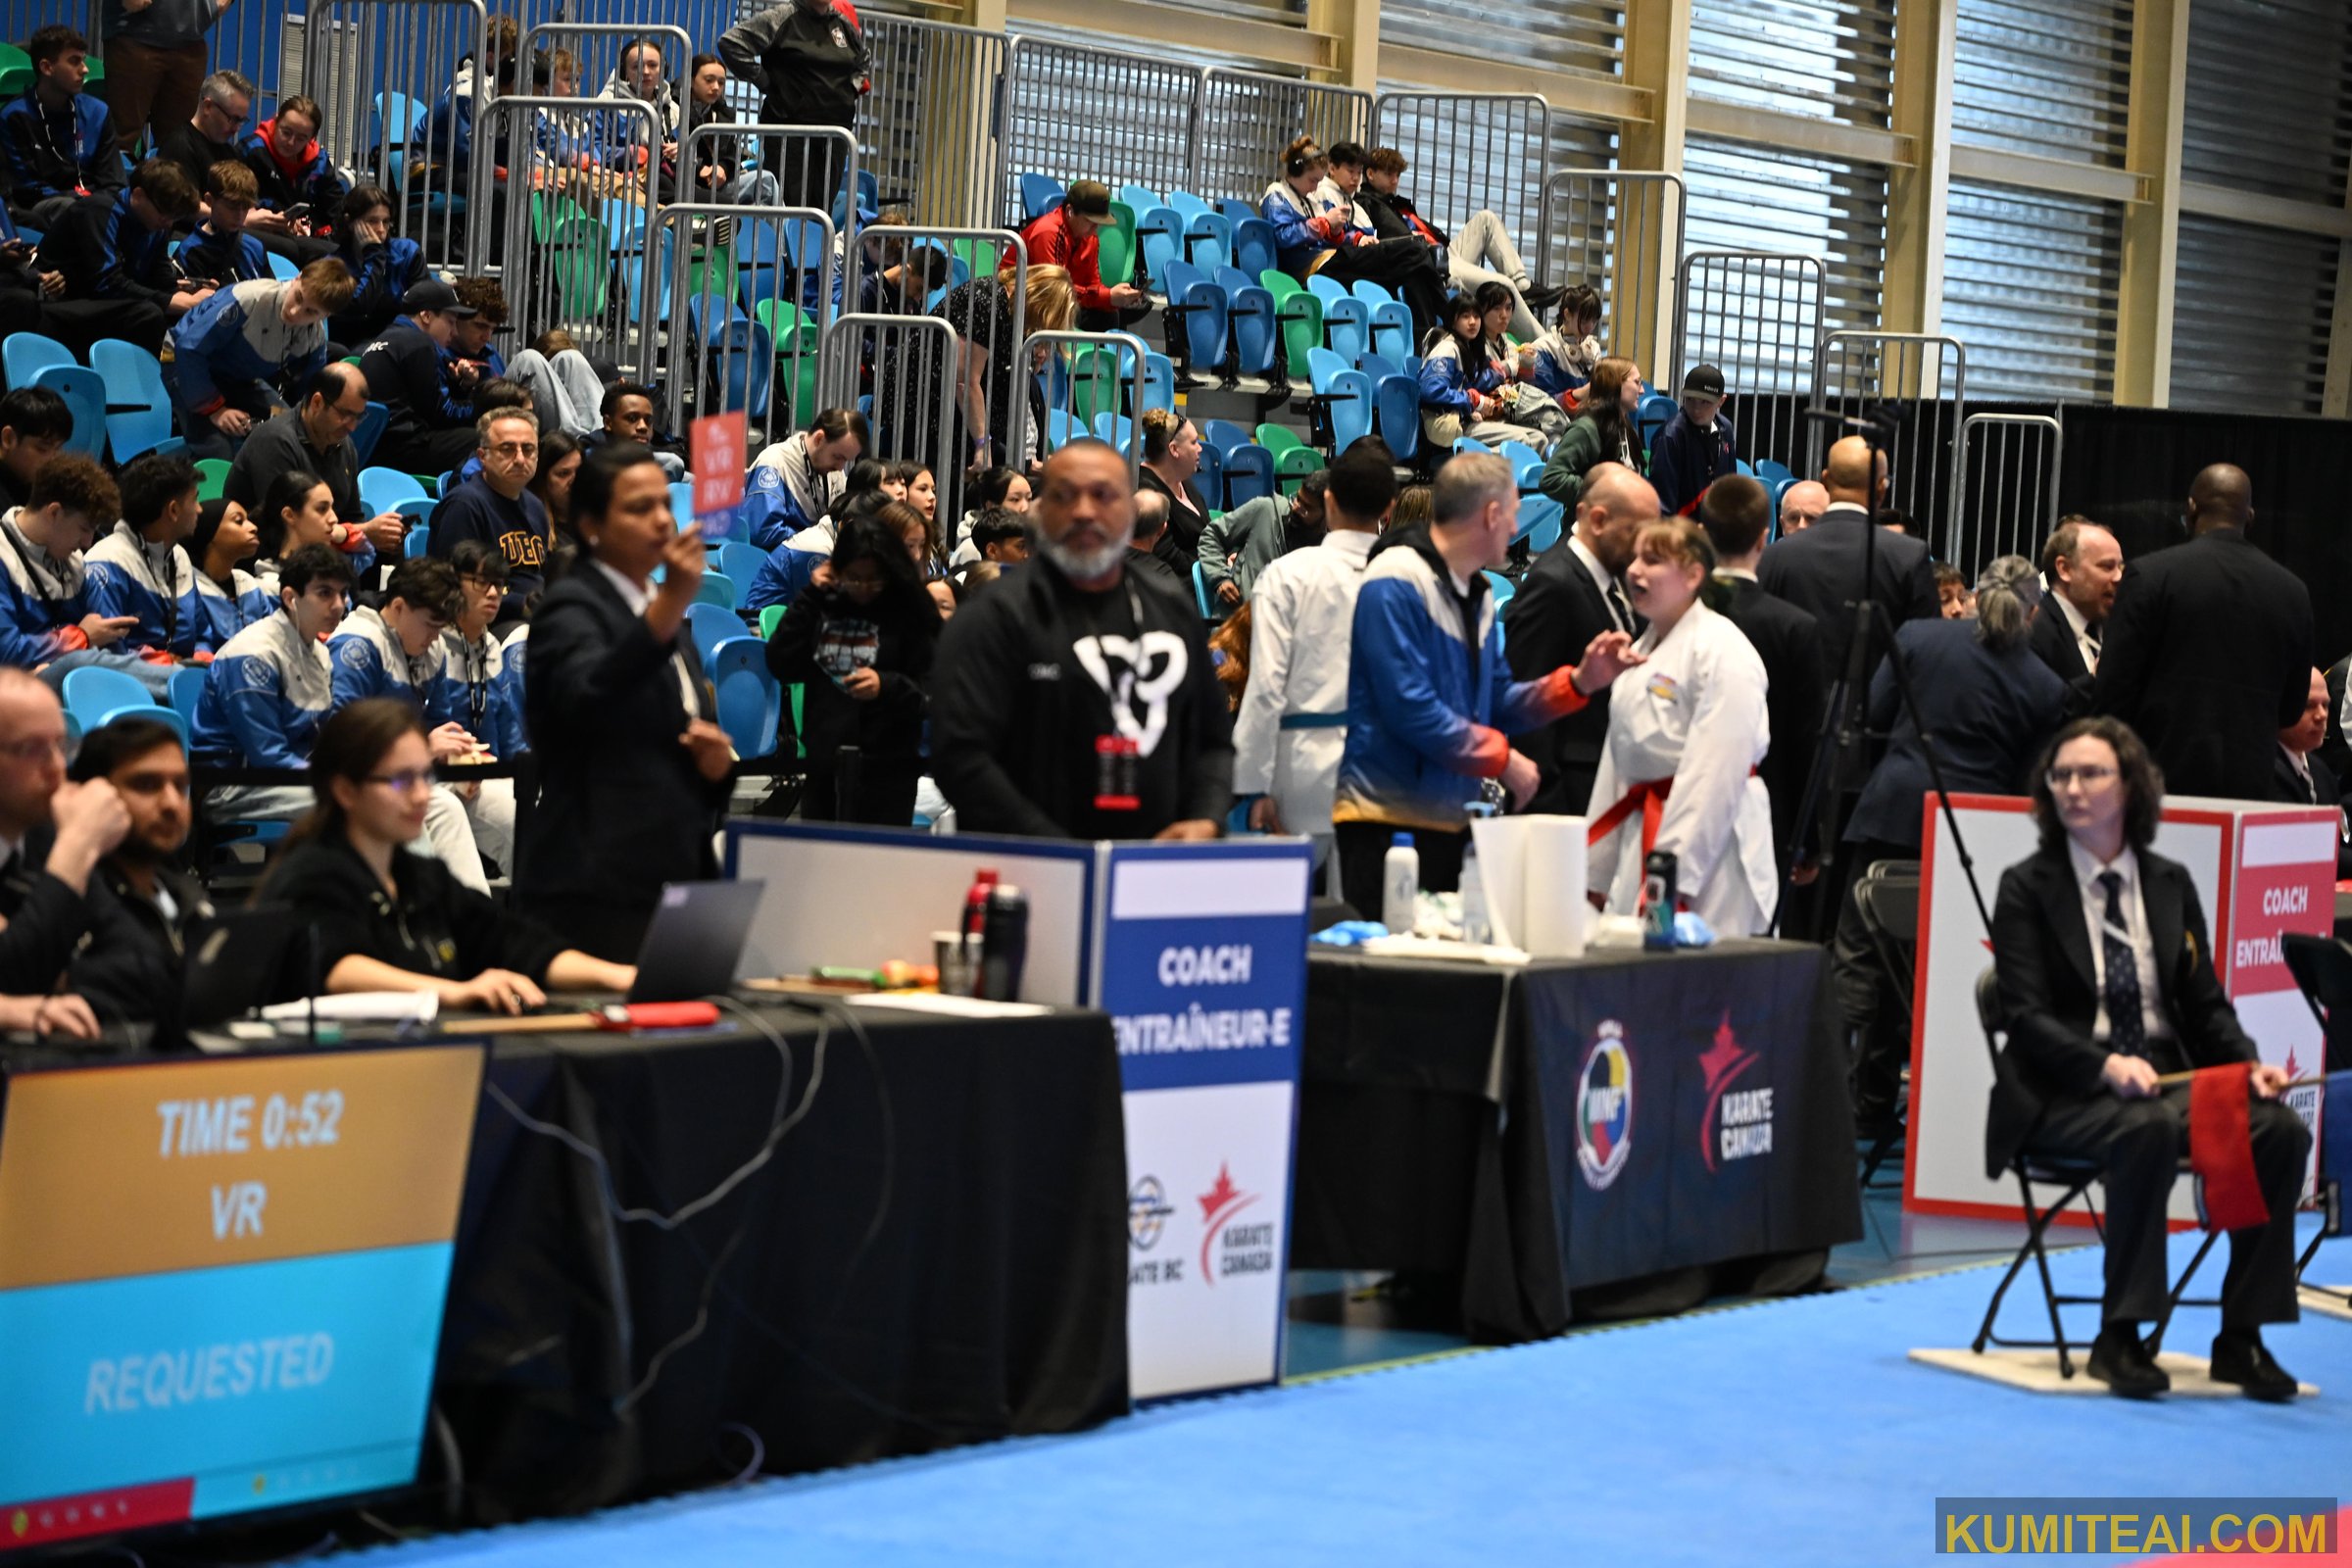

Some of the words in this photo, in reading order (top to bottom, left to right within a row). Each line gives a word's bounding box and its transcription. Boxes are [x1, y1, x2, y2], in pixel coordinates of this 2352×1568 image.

[2263, 886, 2309, 916] COACH
[1157, 943, 1253, 987] COACH
[2235, 928, 2284, 968] ENTRAÎ
[157, 1095, 256, 1157] TIME
[261, 1089, 344, 1150] 0:52
[210, 1180, 268, 1241] VR
[84, 1331, 334, 1415] REQUESTED
